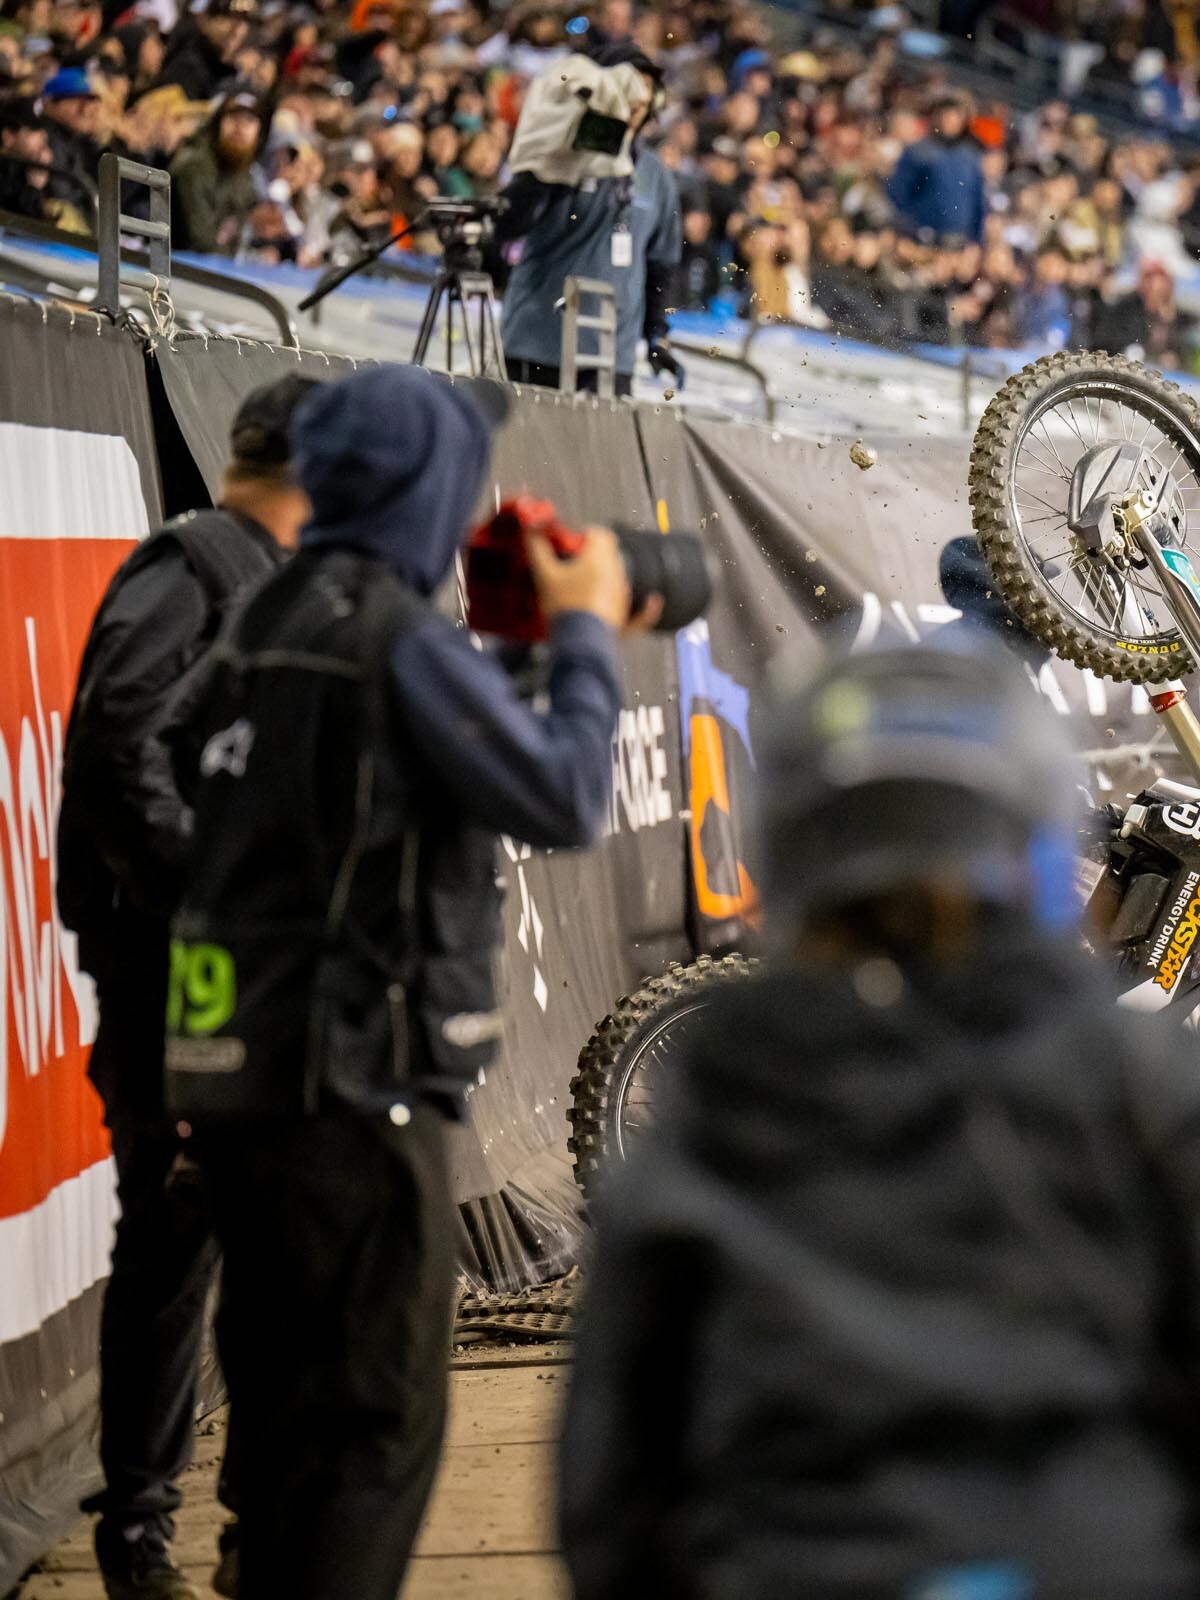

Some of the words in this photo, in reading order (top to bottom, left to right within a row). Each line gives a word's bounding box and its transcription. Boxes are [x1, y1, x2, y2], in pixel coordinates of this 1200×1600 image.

[1116, 641, 1180, 654] DUNLOP
[1167, 871, 1200, 926] ENERGY
[1147, 926, 1174, 969] DRINK
